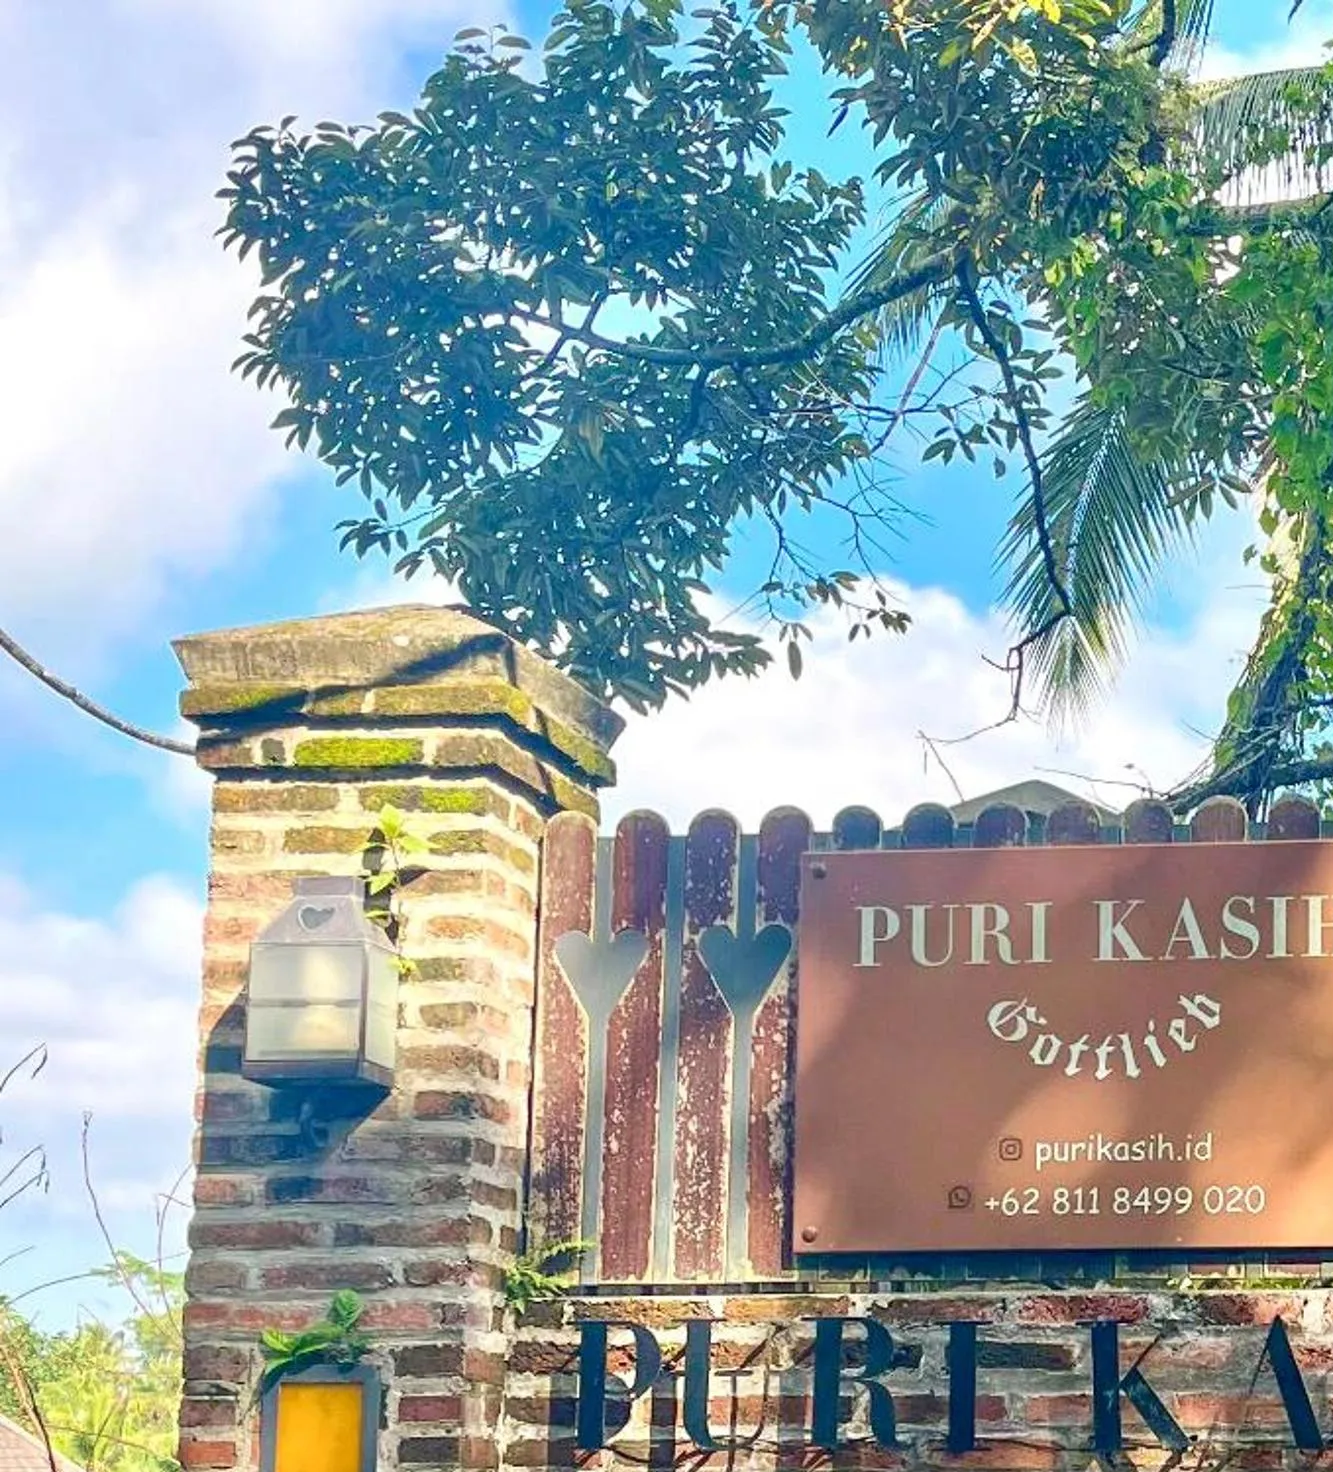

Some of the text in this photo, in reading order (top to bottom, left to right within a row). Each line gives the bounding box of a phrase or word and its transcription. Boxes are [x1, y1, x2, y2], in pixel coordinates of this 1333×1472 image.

[852, 901, 1053, 968] PURI
[986, 990, 1223, 1081] Gottlieb
[1035, 1133, 1213, 1171] purikasih.id
[984, 1184, 1267, 1218] +62 811 8499 020
[574, 1314, 993, 1454] PURI
